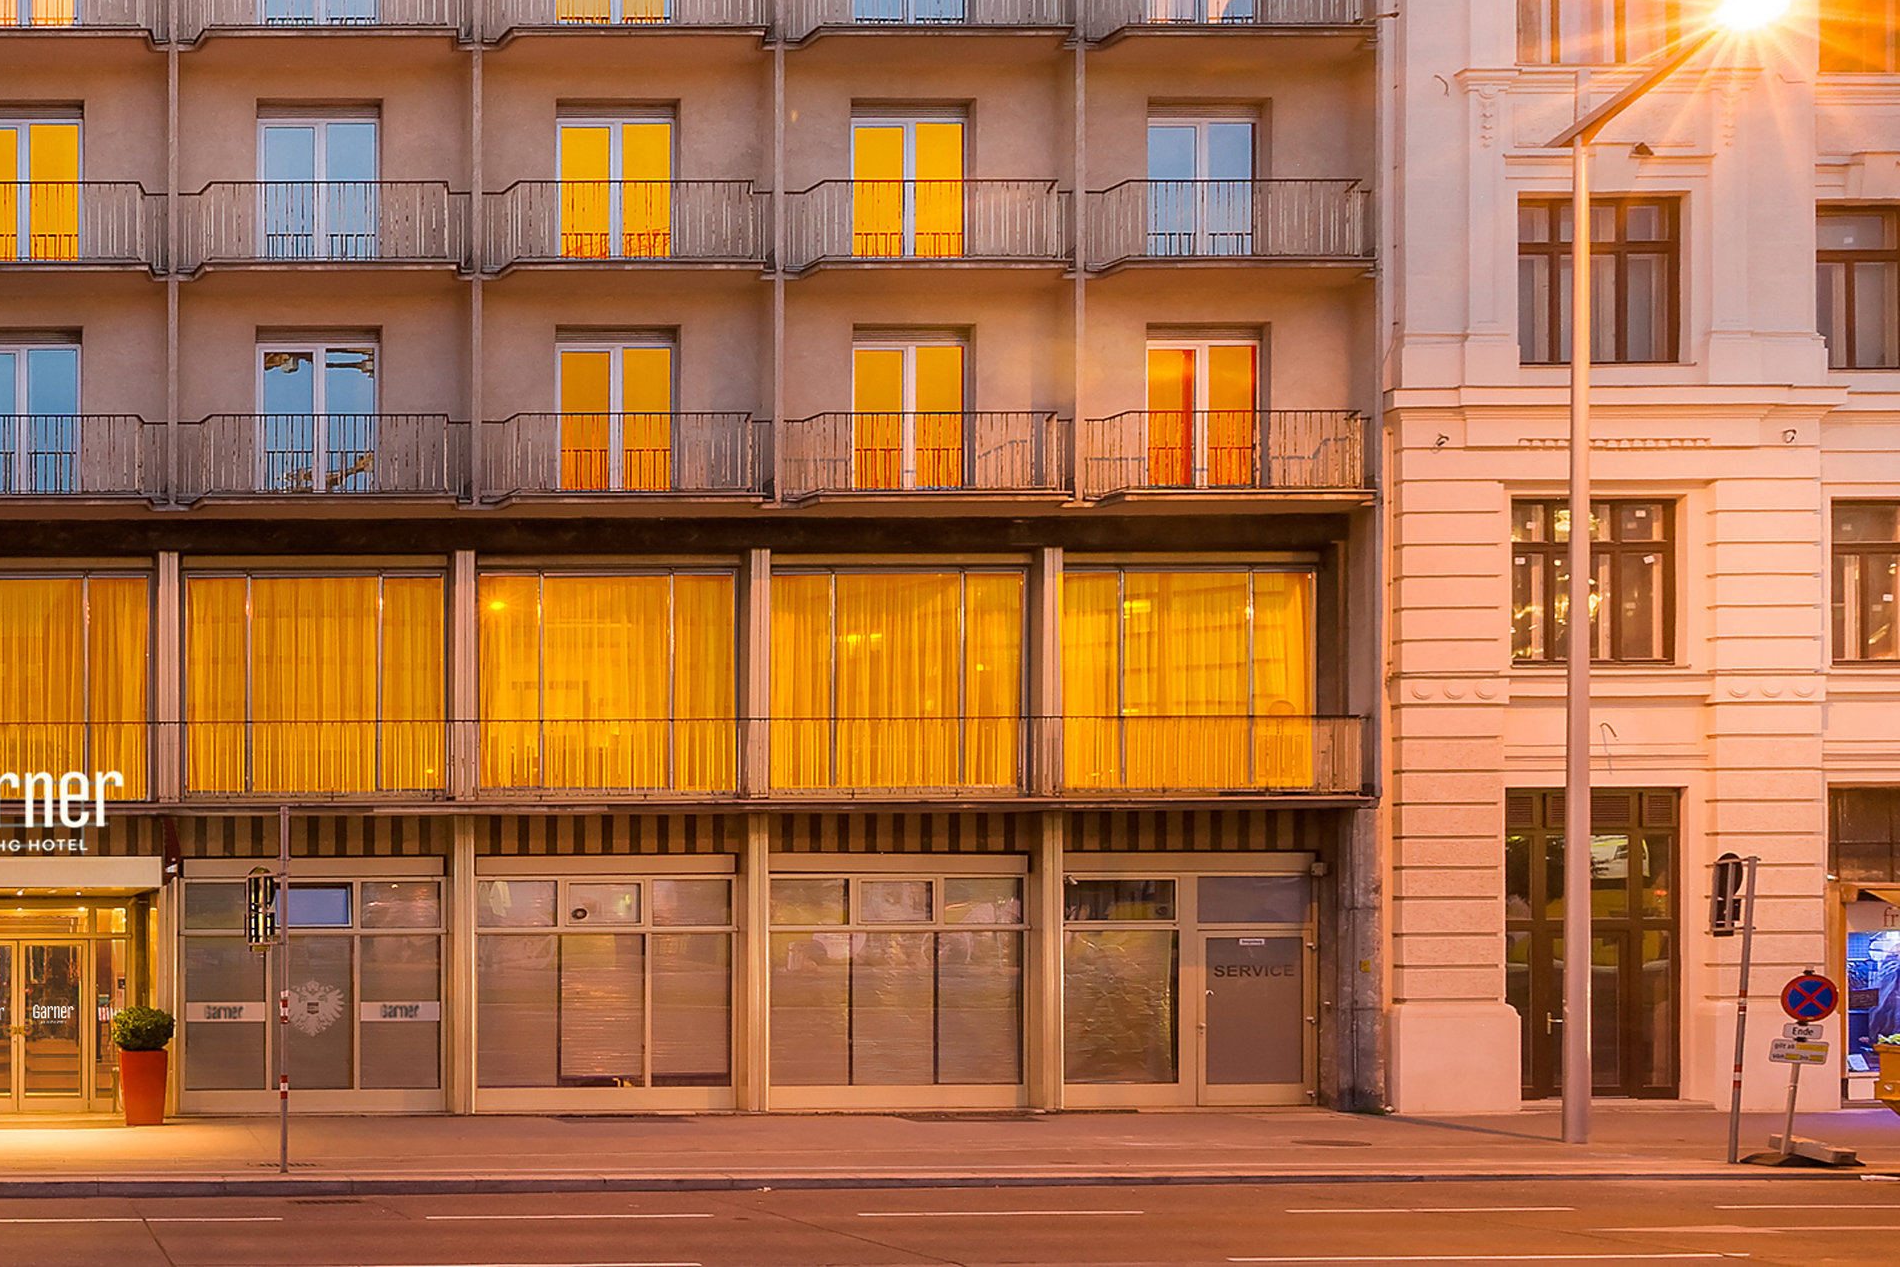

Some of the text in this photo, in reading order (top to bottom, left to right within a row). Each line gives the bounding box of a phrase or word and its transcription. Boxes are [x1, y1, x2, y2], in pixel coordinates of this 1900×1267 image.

[28, 838, 88, 852] HOTEL
[1213, 964, 1295, 977] SERVICE
[32, 1004, 75, 1019] Garner
[204, 1004, 244, 1019] Garner
[380, 1003, 420, 1019] Garner
[1792, 1026, 1814, 1036] Ende
